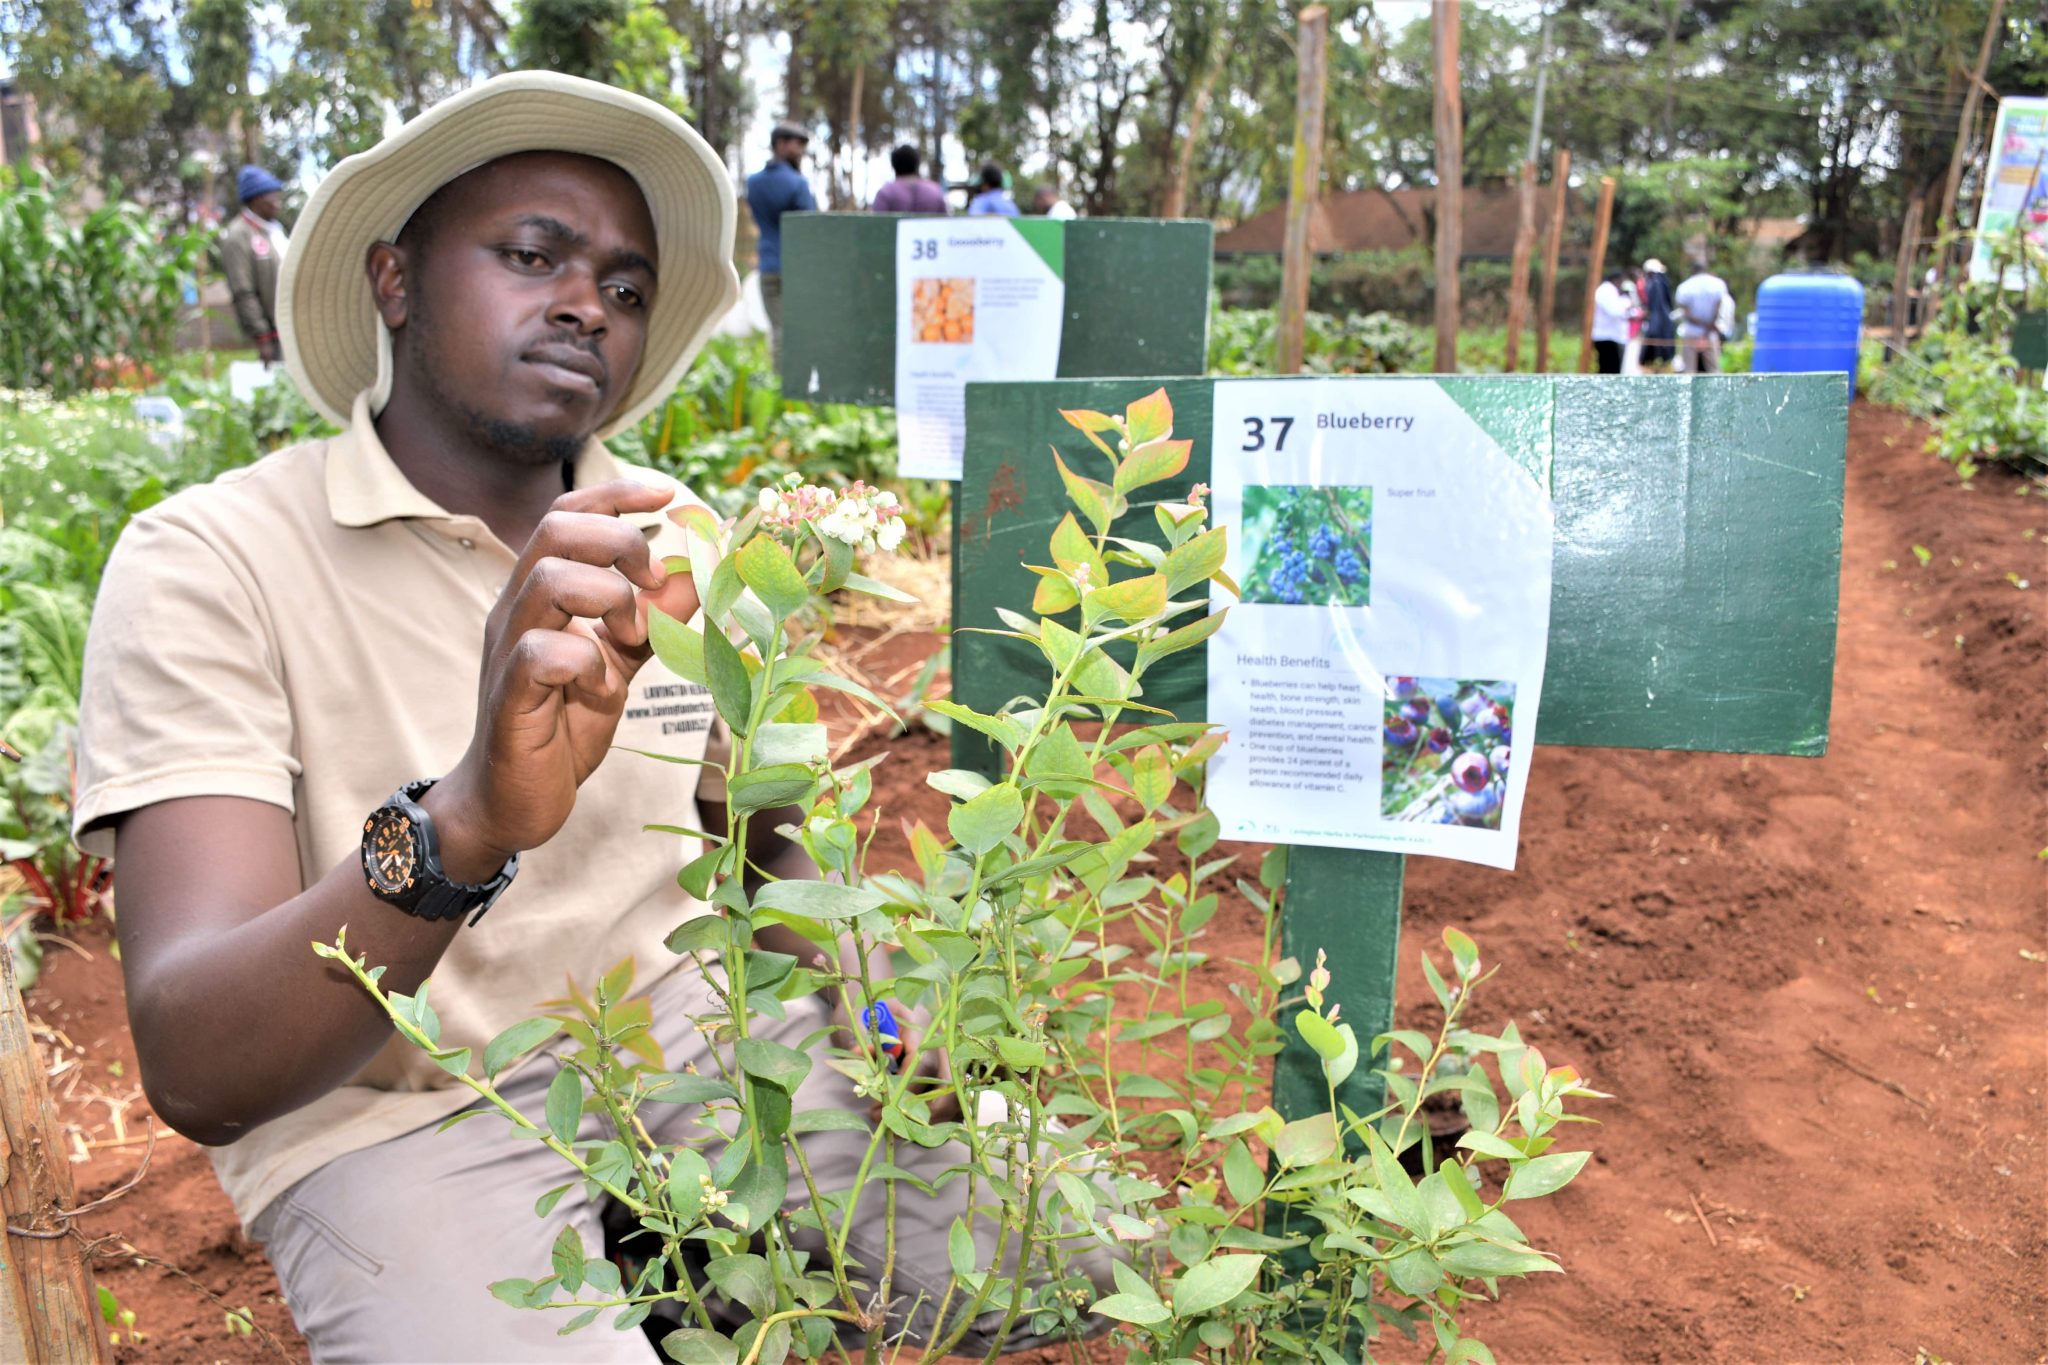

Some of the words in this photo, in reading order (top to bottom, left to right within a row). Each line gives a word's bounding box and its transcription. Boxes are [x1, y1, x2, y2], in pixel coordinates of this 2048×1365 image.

[911, 238, 938, 260] 38
[1316, 412, 1415, 432] Blueberry
[1241, 416, 1295, 452] 37
[1387, 487, 1414, 499] Super
[1416, 487, 1436, 498] fruit
[1236, 654, 1277, 667] Health
[1280, 655, 1331, 669] Benefits
[1250, 678, 1298, 689] Blueberries
[1300, 681, 1316, 690] can
[1318, 681, 1337, 692] help
[1338, 682, 1361, 693] heart
[1280, 692, 1302, 702] bone
[1343, 696, 1361, 705] skin
[1279, 706, 1304, 716] blood
[1249, 717, 1285, 728] diabetes
[1348, 723, 1377, 732] cancer
[1297, 733, 1314, 742] and
[1315, 734, 1345, 743] mental
[1249, 742, 1266, 751] One
[1268, 745, 1284, 754] cup
[1285, 744, 1295, 753] of
[1296, 745, 1344, 756] blueberries
[1249, 754, 1285, 765] provides
[1287, 756, 1298, 765] 24
[1300, 759, 1332, 769] percent
[1334, 759, 1343, 768] of
[1249, 767, 1278, 776] person
[1280, 769, 1341, 781] recommended
[1343, 772, 1363, 783] daily
[1249, 779, 1291, 789] allowance
[1293, 782, 1302, 791] of
[1304, 783, 1335, 793] vitamin
